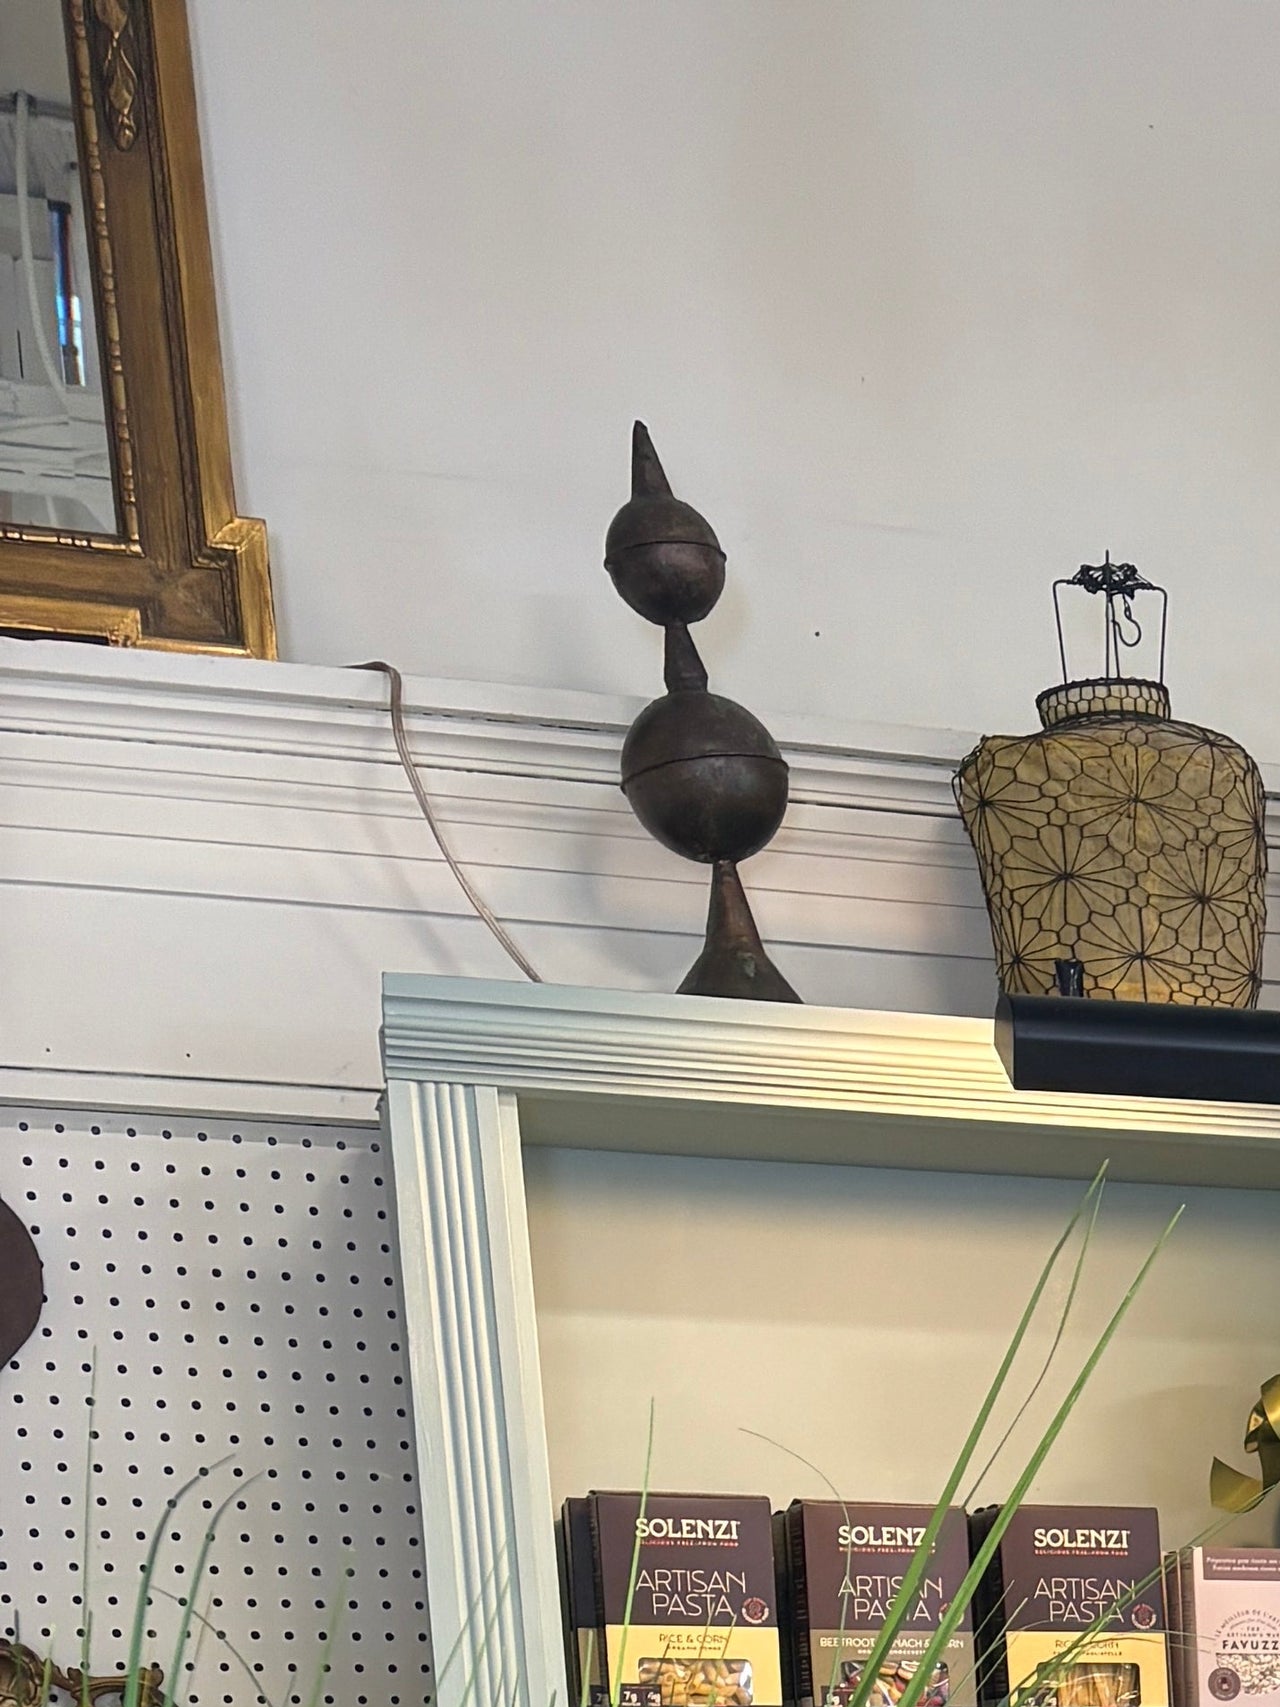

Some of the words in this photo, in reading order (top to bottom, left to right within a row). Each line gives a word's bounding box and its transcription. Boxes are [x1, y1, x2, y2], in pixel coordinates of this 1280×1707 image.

[635, 1518, 738, 1539] SOLENZI
[838, 1524, 936, 1547] SOLENZ
[1034, 1529, 1130, 1549] SOLENZI
[635, 1569, 747, 1594] ARTISAN
[1034, 1577, 1136, 1600] ARTISAN
[652, 1593, 735, 1617] PASTA
[1049, 1600, 1125, 1624] PASTA
